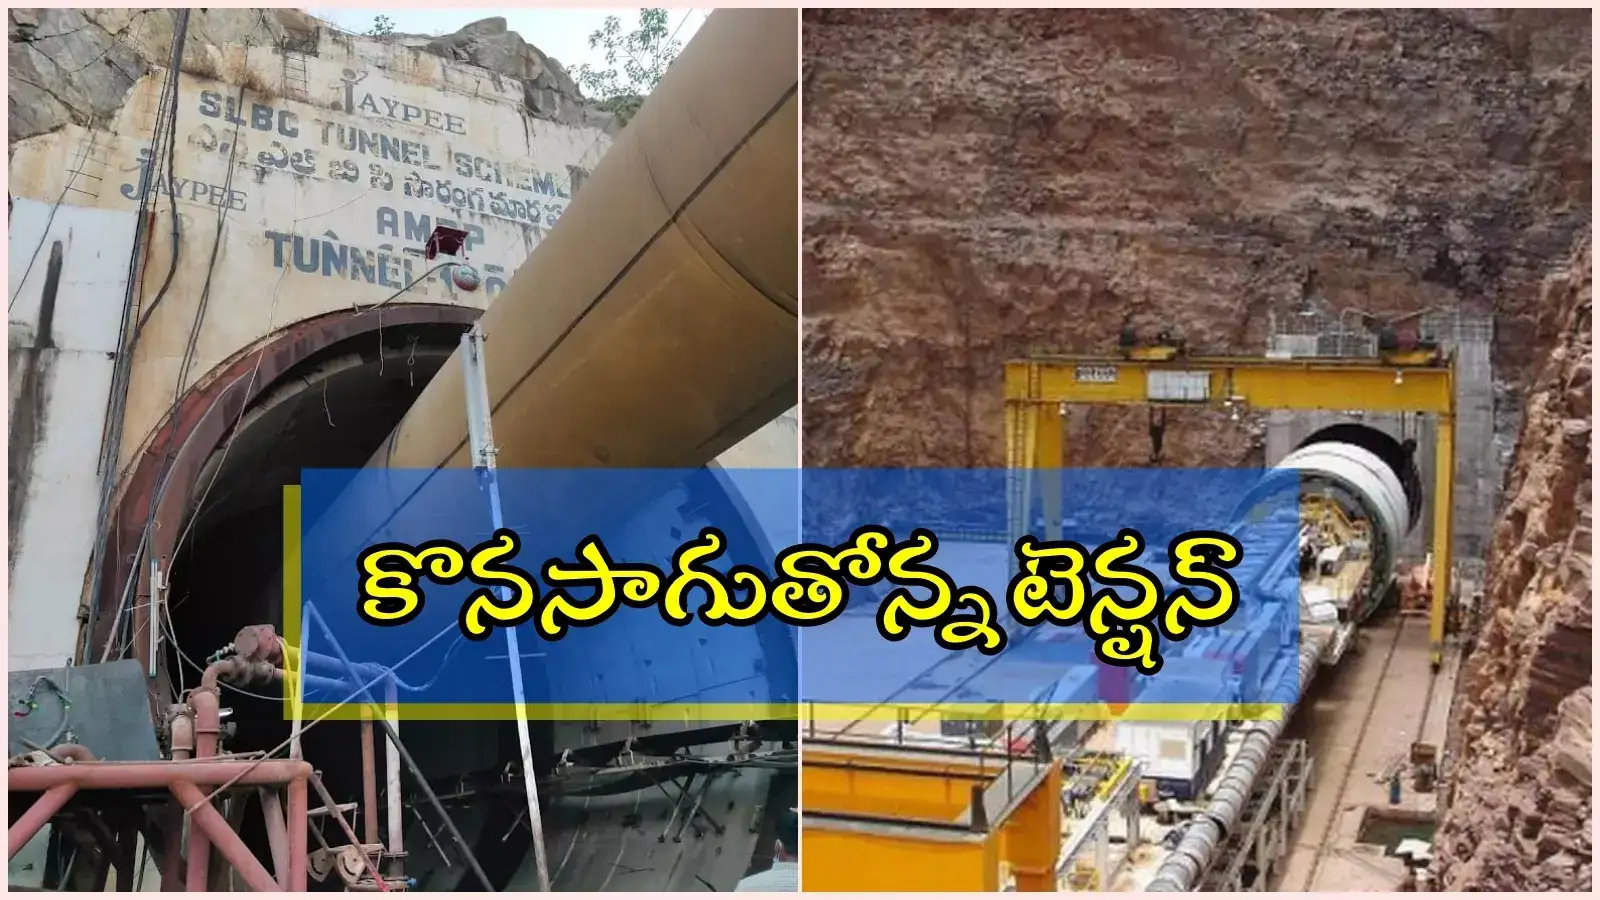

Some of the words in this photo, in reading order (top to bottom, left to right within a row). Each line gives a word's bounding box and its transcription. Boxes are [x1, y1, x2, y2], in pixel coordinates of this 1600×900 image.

[199, 89, 300, 138] SLBC
[315, 118, 441, 171] TUNNEL
[376, 206, 485, 251] AMP
